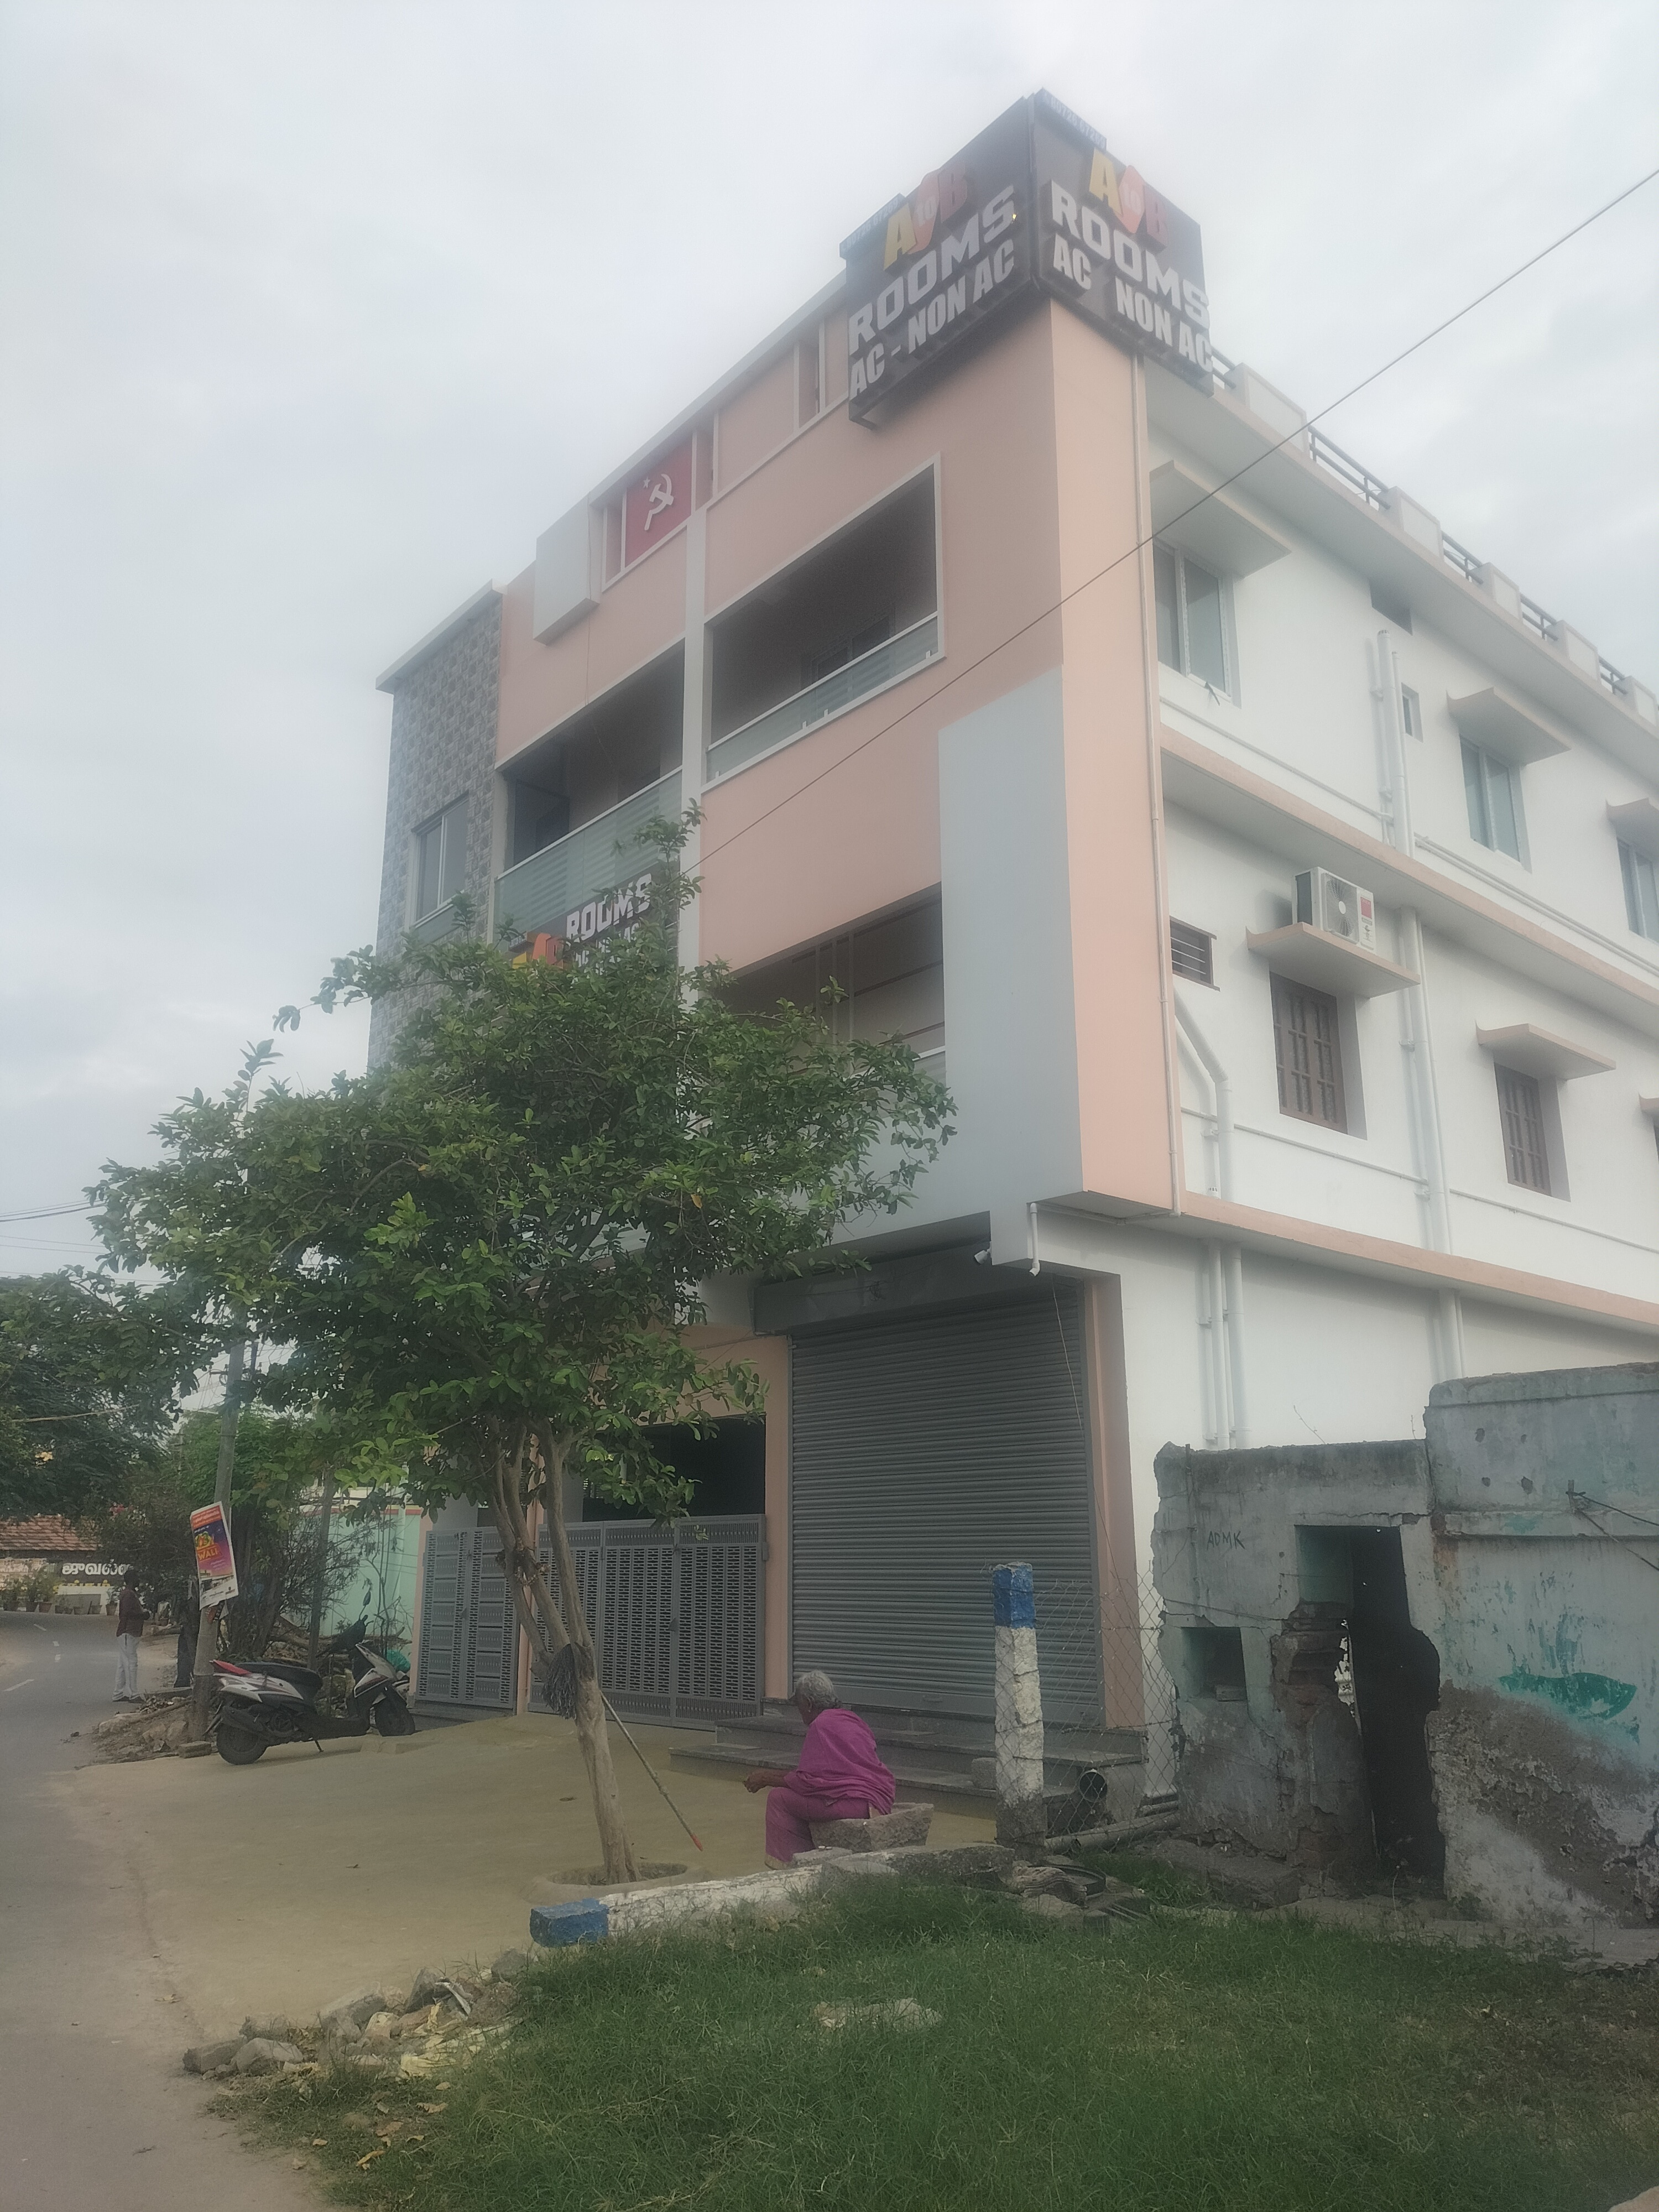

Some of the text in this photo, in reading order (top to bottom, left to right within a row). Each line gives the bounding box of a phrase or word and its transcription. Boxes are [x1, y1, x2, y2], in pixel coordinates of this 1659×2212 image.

[849, 185, 1015, 356] ROOMS
[849, 342, 885, 401] AC
[909, 275, 966, 354] NON
[973, 239, 1014, 304] AC
[1051, 180, 1210, 330] ROOMS
[1053, 233, 1213, 373] AC NON AC
[566, 873, 651, 942] ROOMS
[1207, 1531, 1245, 1550] ADMK
